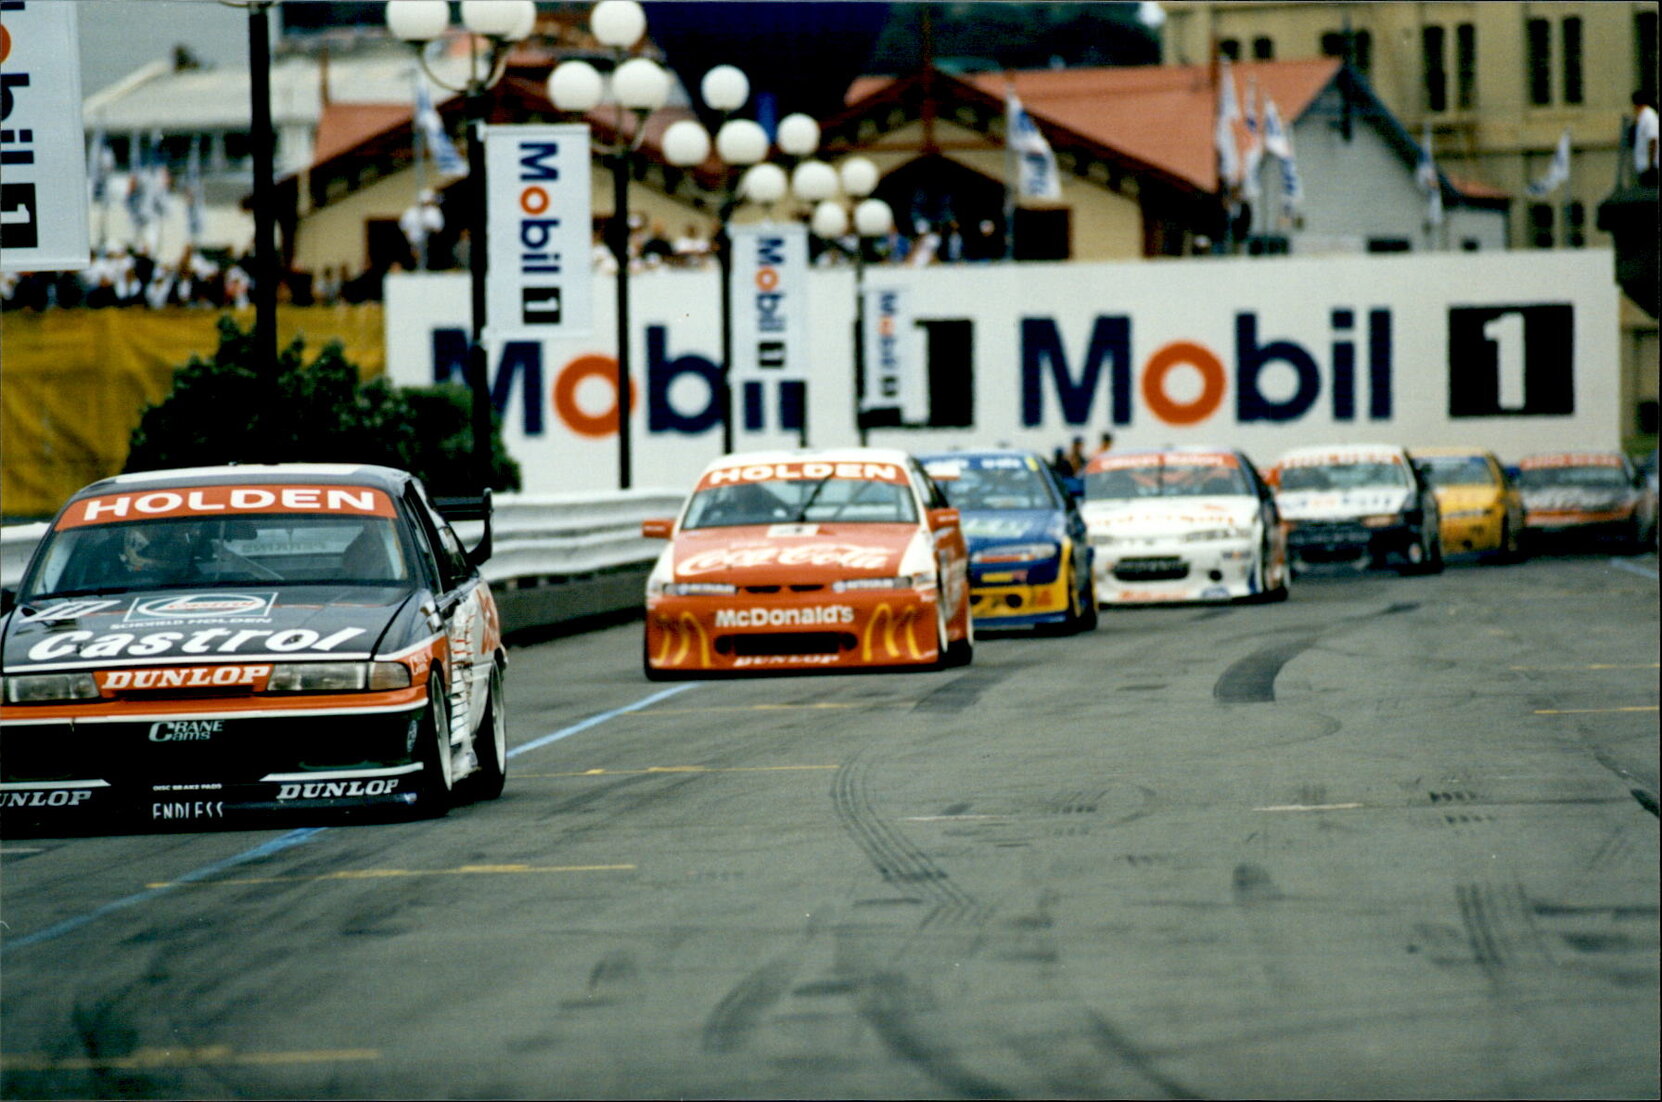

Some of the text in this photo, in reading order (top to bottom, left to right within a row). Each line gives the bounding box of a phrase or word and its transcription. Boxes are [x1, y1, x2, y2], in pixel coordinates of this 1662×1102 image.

[519, 141, 561, 274] Mobil
[756, 236, 785, 332] Mobil
[1020, 307, 1392, 427] Mobil
[710, 463, 896, 484] HOLDEN
[83, 488, 375, 521] HOLDEN
[187, 617, 273, 626] HOLDEN
[715, 604, 854, 627] McDonald's
[28, 626, 366, 661] Castrol
[102, 665, 271, 690] DUNLOP
[148, 720, 224, 742] CRANE
[276, 778, 400, 800] DUNLOP
